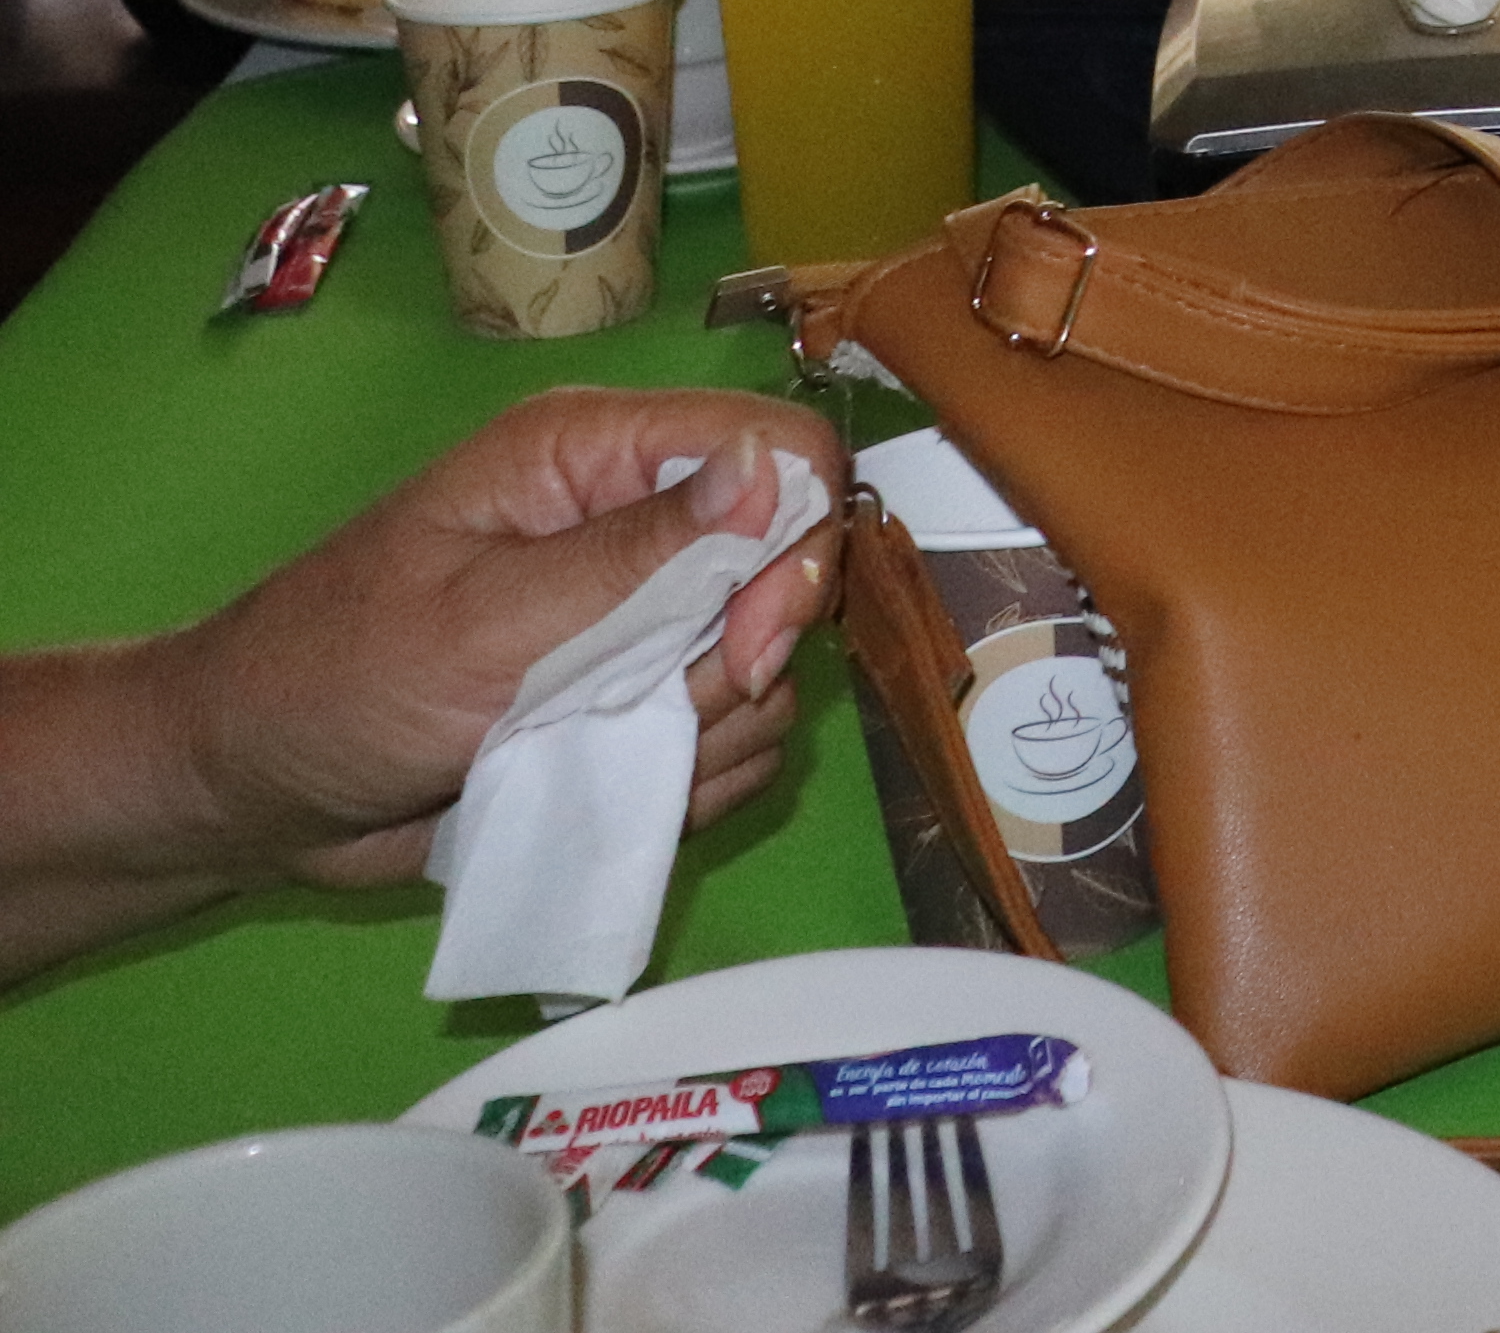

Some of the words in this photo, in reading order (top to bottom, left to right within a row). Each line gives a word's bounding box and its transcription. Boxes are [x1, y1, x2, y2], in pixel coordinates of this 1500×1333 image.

[898, 1059, 919, 1075] de
[909, 1091, 966, 1106] importar
[576, 1088, 718, 1133] RIOPAILA
